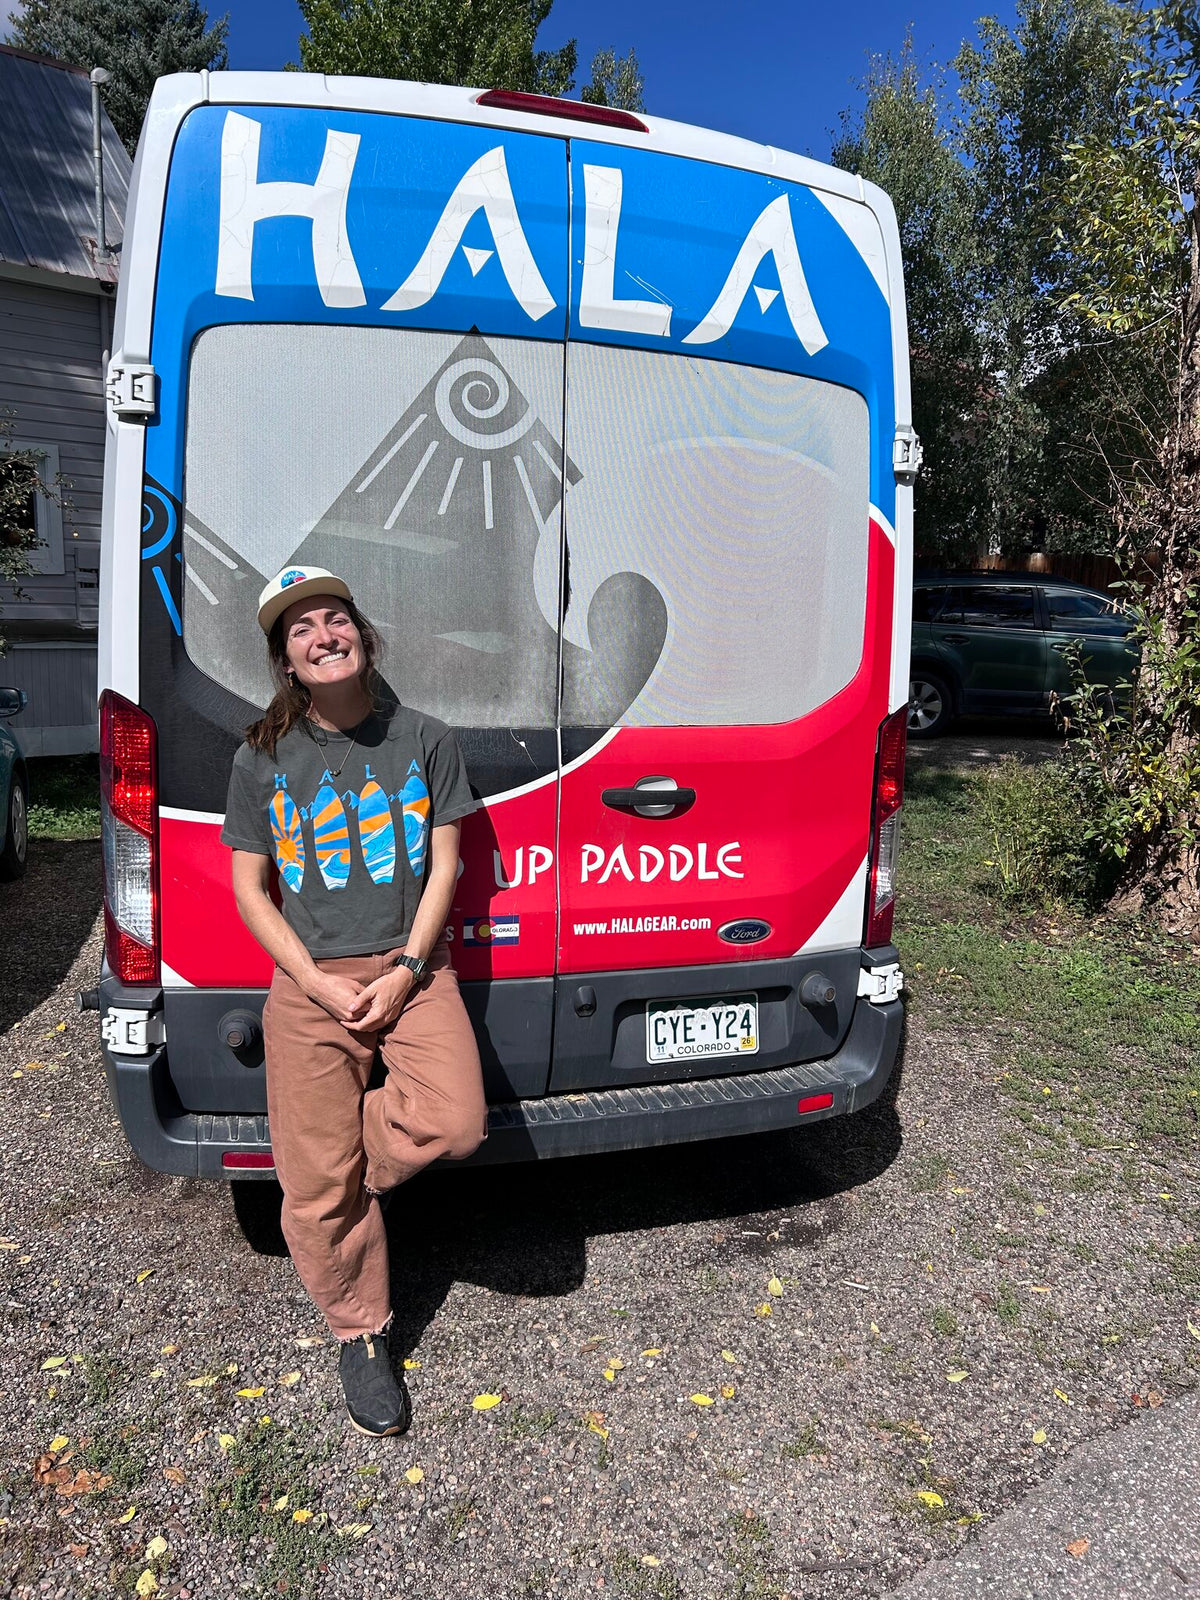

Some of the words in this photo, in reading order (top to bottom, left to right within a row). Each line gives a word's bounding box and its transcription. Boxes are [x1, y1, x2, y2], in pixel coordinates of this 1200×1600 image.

[215, 111, 829, 356] HALA
[493, 845, 553, 888] UP
[580, 841, 744, 884] PADDLE
[573, 916, 711, 935] www.HALAGEAR.com
[731, 926, 760, 939] Ford
[677, 1042, 731, 1055] COLORADO
[741, 1037, 751, 1045] 26
